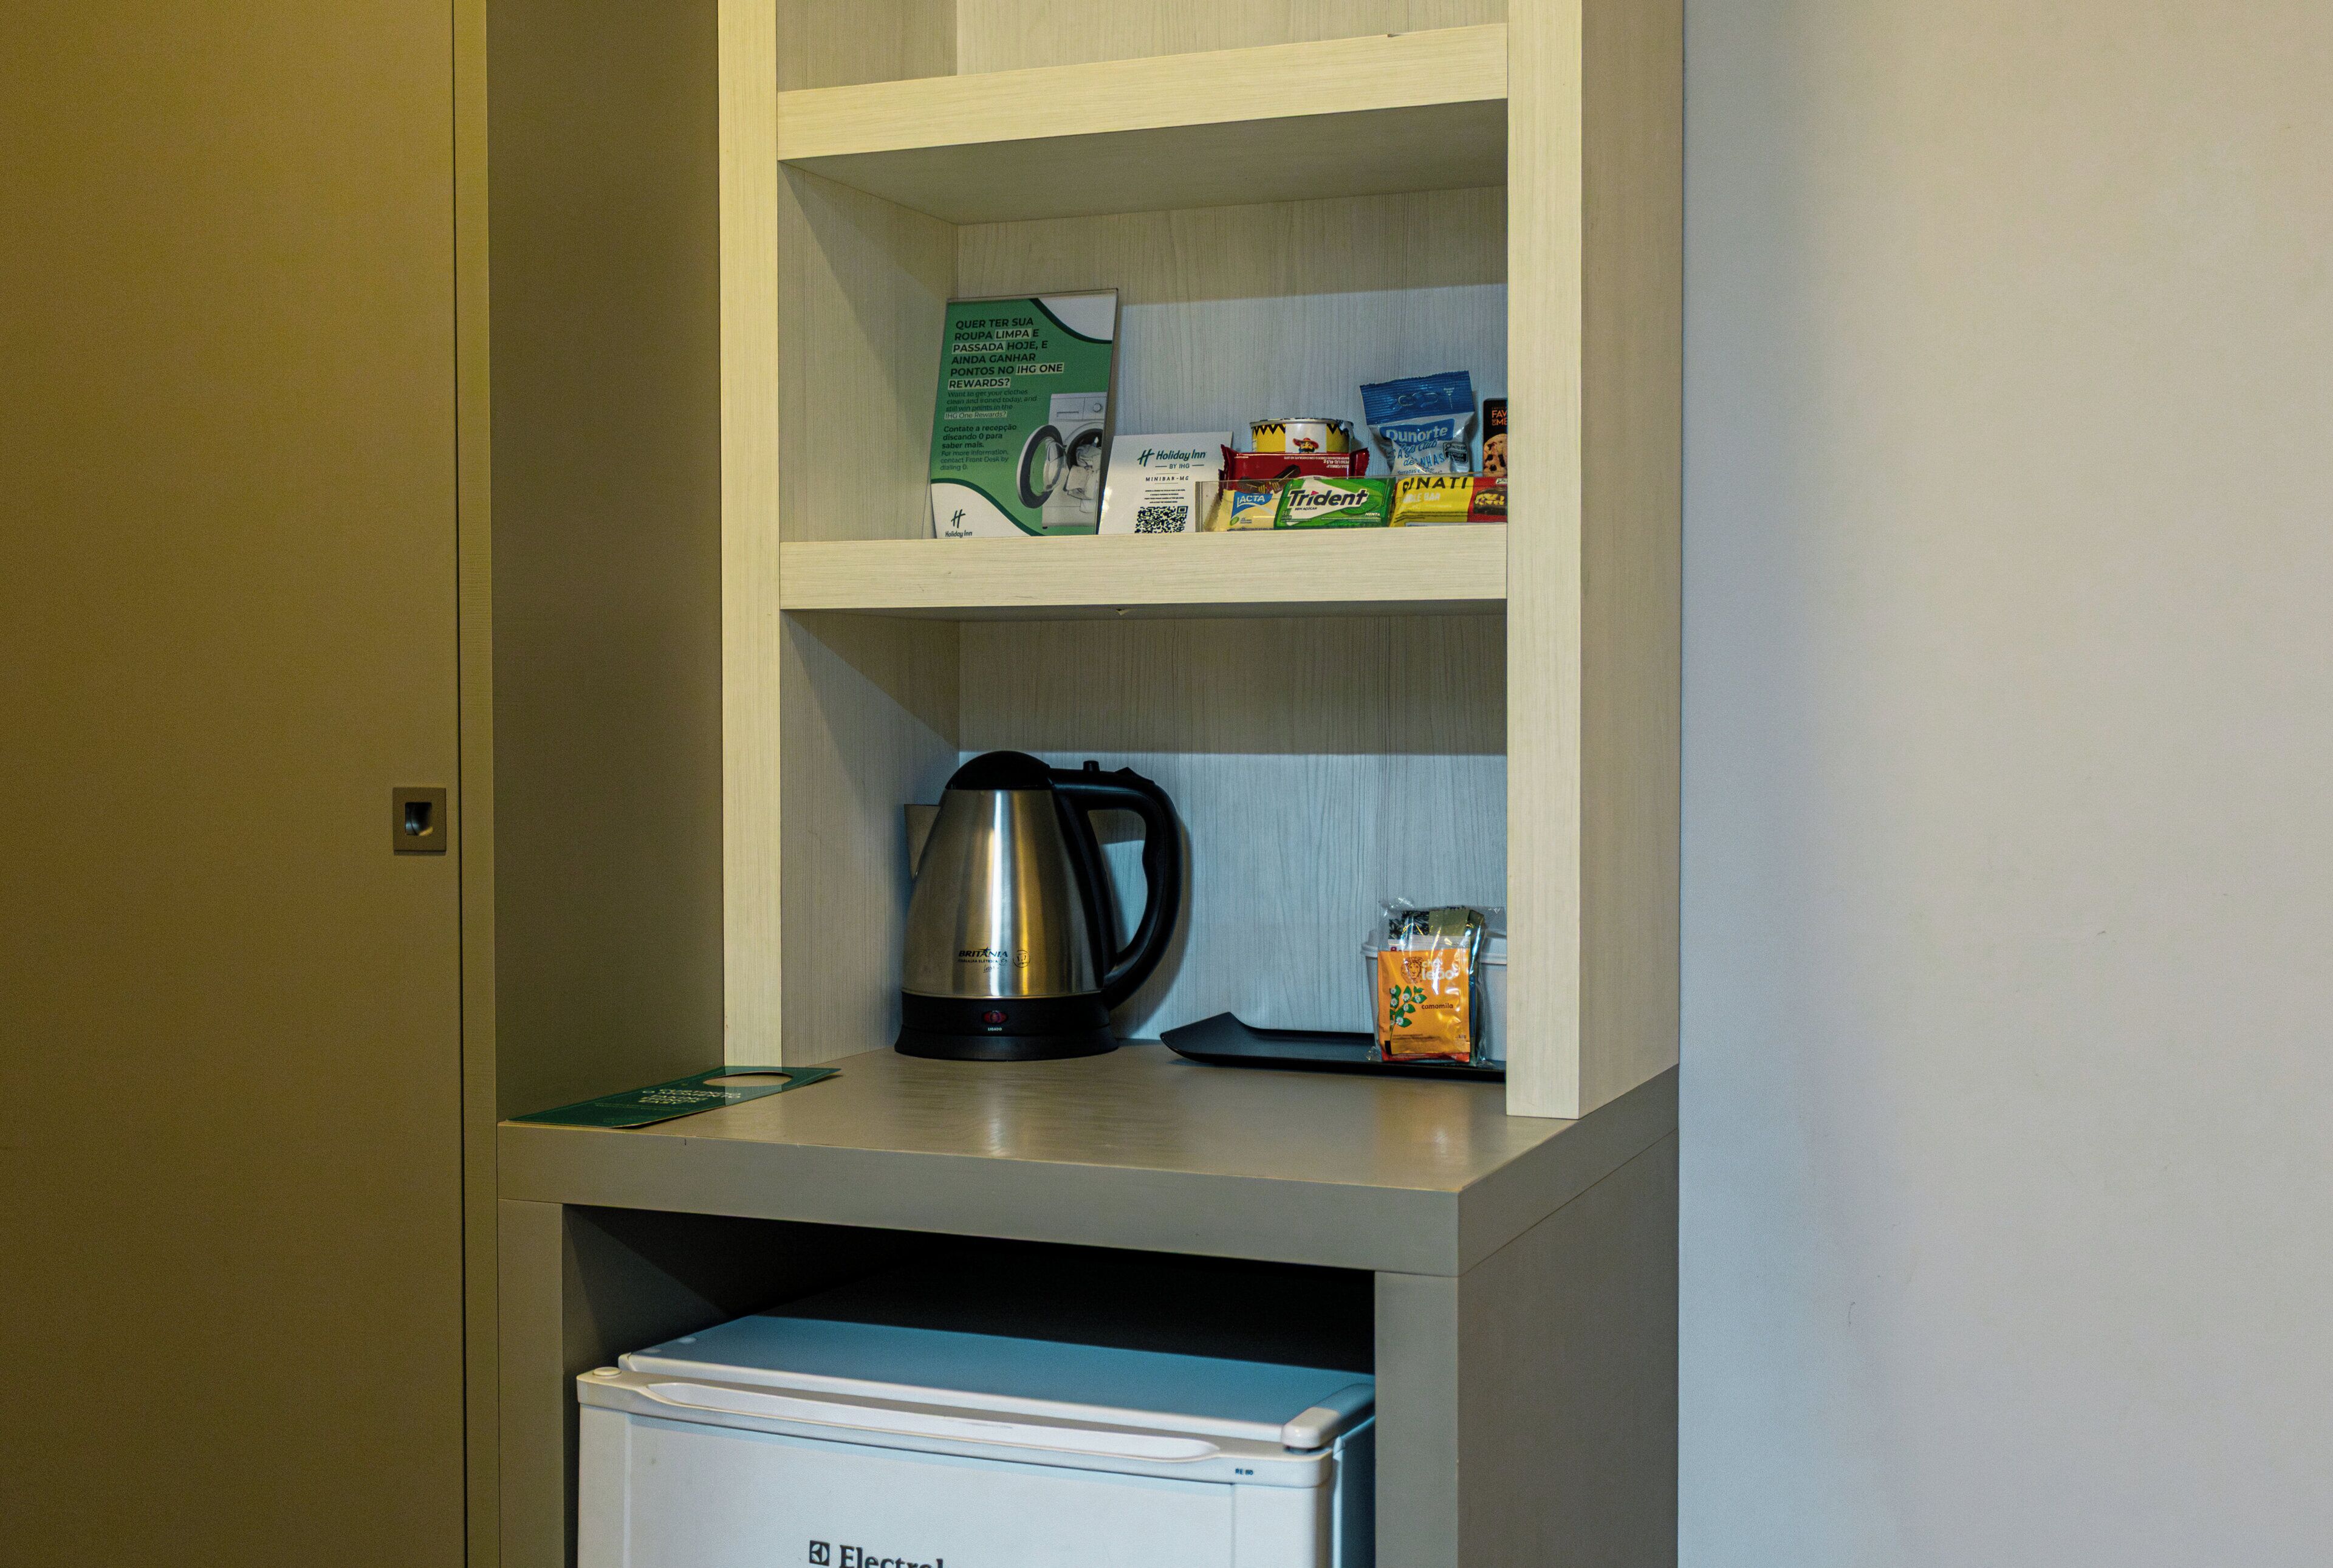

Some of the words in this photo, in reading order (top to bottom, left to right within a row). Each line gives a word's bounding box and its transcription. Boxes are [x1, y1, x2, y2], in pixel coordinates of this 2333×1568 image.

[956, 319, 985, 330] QUER
[989, 318, 1009, 327] TER
[1012, 318, 1033, 327] SUA
[954, 331, 993, 341] ROUPA
[996, 330, 1029, 339] LIMPA
[953, 343, 1004, 352] PASSADA
[1007, 341, 1038, 351] HOJE,
[951, 355, 985, 365] AINDA
[989, 354, 1036, 363] GANHAR
[951, 366, 995, 377] PONTOS
[998, 366, 1014, 375] NO
[1017, 365, 1036, 374] IHG
[1040, 363, 1063, 373] ONE
[949, 378, 1010, 389] REWARDS?
[1386, 426, 1448, 443] Dunorte
[1418, 438, 1438, 452] Club
[1156, 450, 1190, 461] Holiday
[1191, 449, 1206, 459] Inn
[1237, 495, 1266, 507] LACTA
[1289, 489, 1368, 507] Trident
